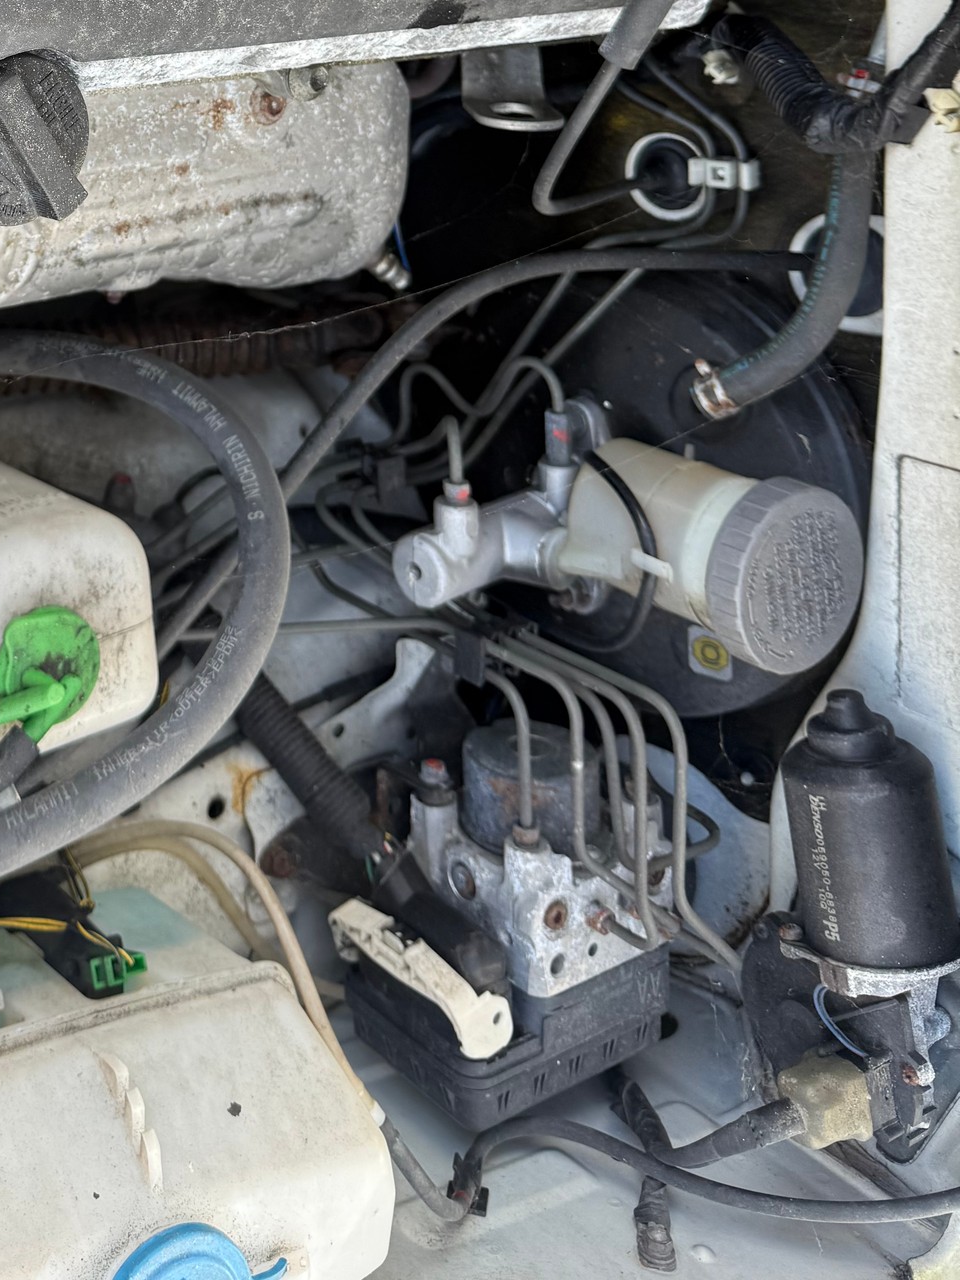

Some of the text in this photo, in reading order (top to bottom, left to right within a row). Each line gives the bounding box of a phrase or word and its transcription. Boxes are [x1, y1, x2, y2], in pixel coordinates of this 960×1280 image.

[171, 380, 227, 432] HYLAMMIT
[222, 434, 261, 500] NICHIRIN
[808, 794, 823, 839] DENSO
[816, 795, 827, 811] LH
[811, 848, 821, 870] 12V
